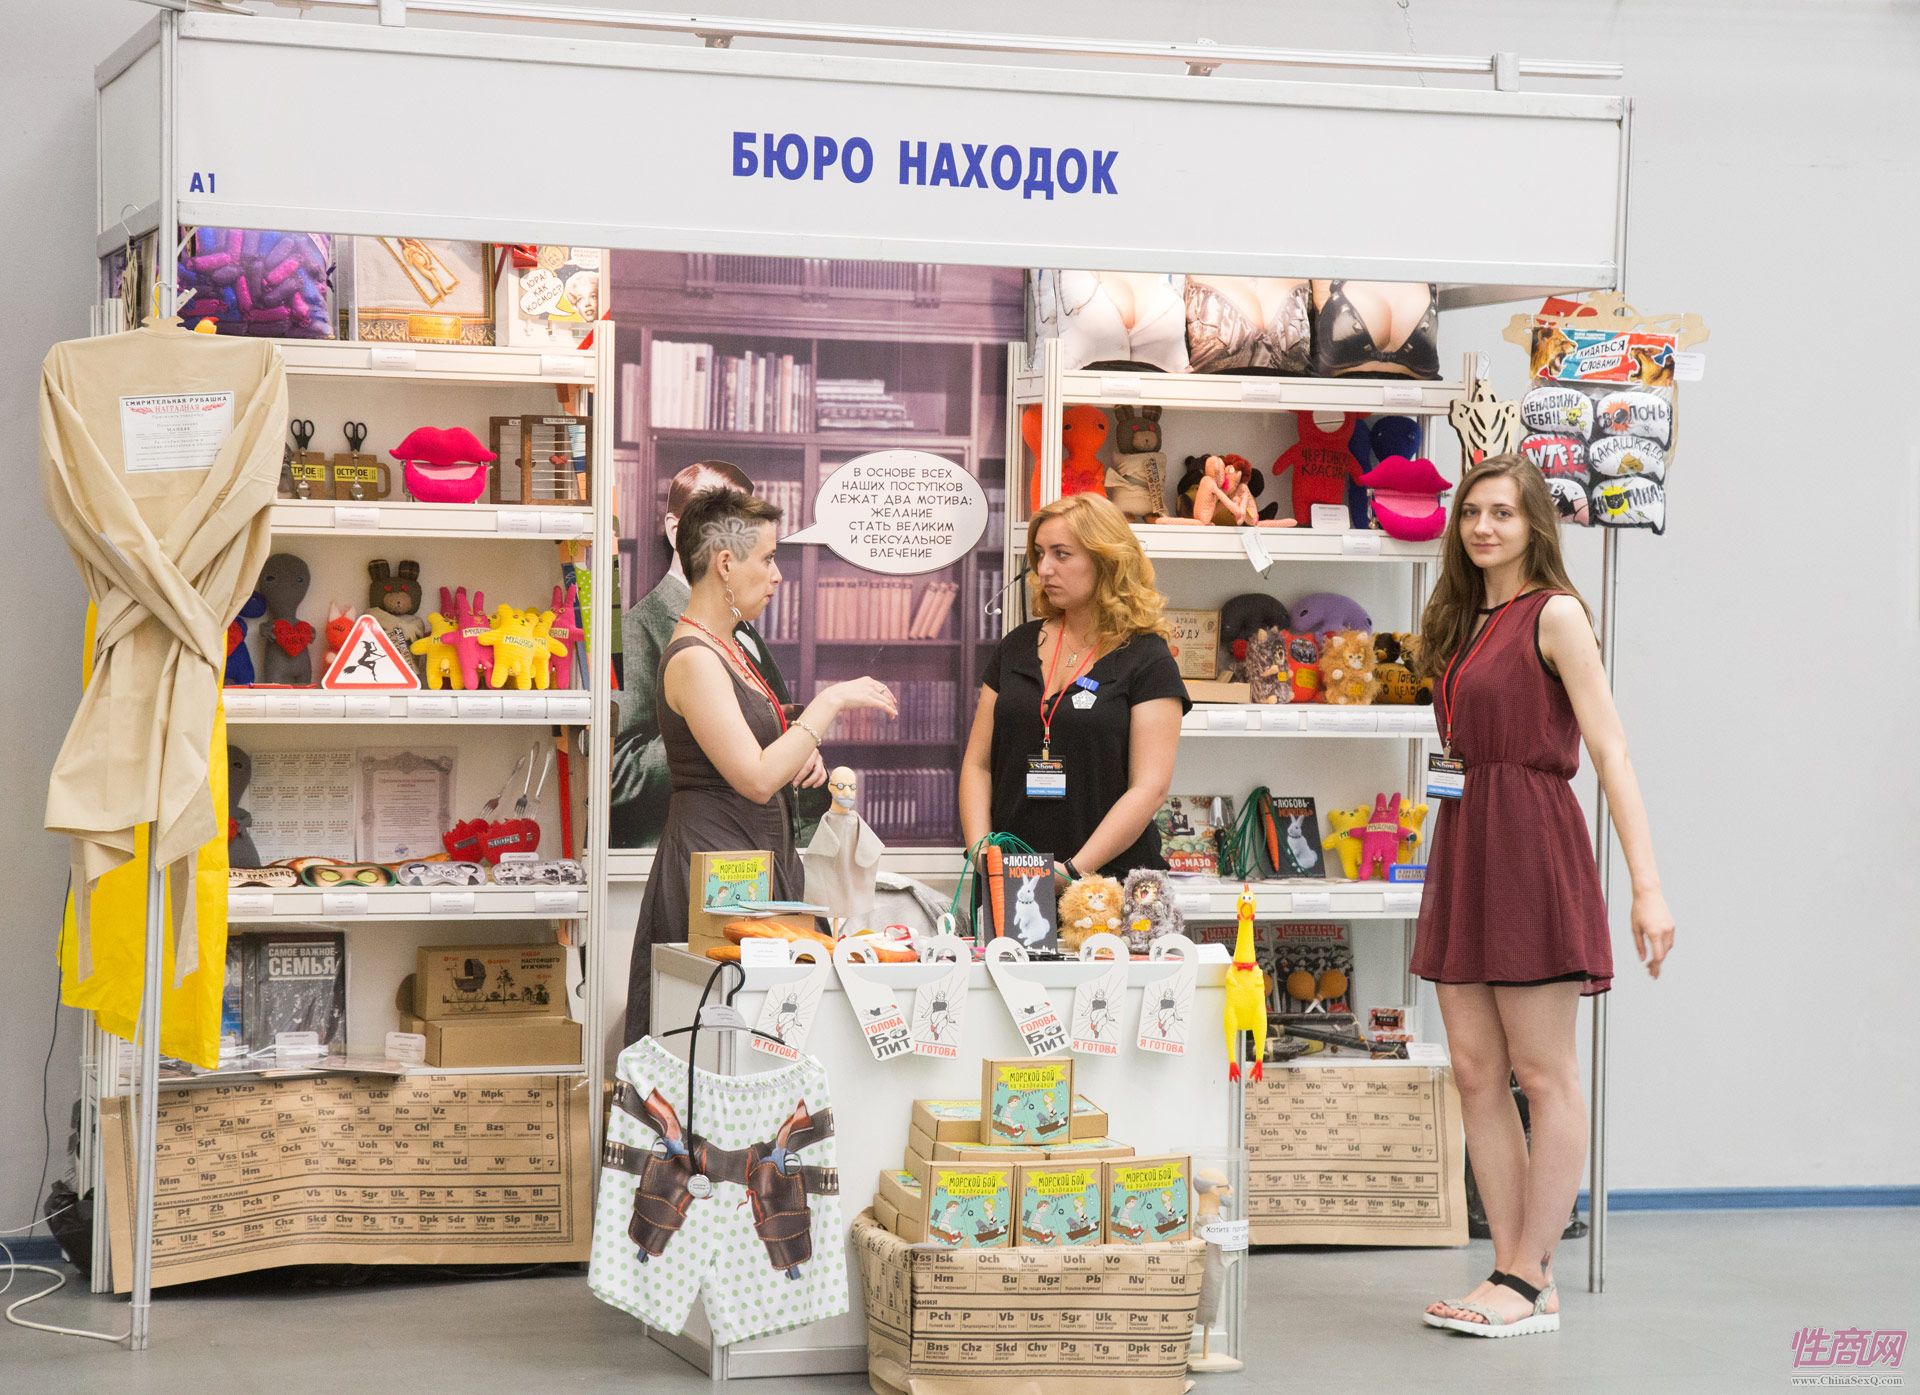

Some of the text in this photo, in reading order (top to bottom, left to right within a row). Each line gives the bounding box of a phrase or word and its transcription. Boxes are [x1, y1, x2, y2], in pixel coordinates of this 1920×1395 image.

[733, 132, 1118, 200] БЮРО НАХОДОК
[534, 285, 548, 296] КАК
[526, 285, 562, 312] КОСМОС?
[1580, 340, 1625, 357] КИДАТЬСЯ
[126, 398, 187, 406] СМИРИТЕЛЬНАЯ
[1524, 394, 1580, 414] НЕНАВИЖУ
[854, 468, 952, 479] В ОСНОВЕ ВСЕХ
[842, 481, 963, 492] НАШИХ ПОСТУПКОВ
[830, 494, 972, 506] ЛЕЖАТ ДВА МОТИВА:
[871, 508, 933, 518] ЖЕЛАНИЕ
[849, 522, 954, 532] СТАТЬ ВЕЛИКИМ
[851, 535, 952, 545] И СЕКСУАЛЬНОЕ
[870, 548, 932, 558] ВЛЕЧЕНИЕ
[720, 862, 758, 874] МОРСКОЙ БОЙ
[268, 948, 298, 957] САМОЕ
[268, 956, 336, 976] СЕМЬЯ
[865, 1017, 904, 1035] ГОЛОВА
[1020, 1016, 1057, 1034] ГОЛОВА
[753, 1039, 798, 1060] Я ГОТОВА
[876, 1037, 911, 1058] ЛИТ
[921, 1043, 957, 1057] ГОТОВА
[1033, 1034, 1065, 1056] ЛИТ
[1073, 1040, 1117, 1054] Я ГОТОВА
[1140, 1039, 1184, 1053] Я ГОТОВА
[1009, 1070, 1055, 1083] МОРСКОЙ БОЙ
[1267, 1082, 1286, 1090] Udv
[369, 1090, 541, 1100] Udv Vp Mpk Sp
[378, 1124, 393, 1133] Dp
[486, 1123, 504, 1131] Bzs
[527, 1123, 541, 1131] Du
[379, 1157, 541, 1165] Pb Ud Ur
[949, 1176, 996, 1188] МОРСКОЙ БОЙ
[1038, 1173, 1085, 1187] МОРСКОЙ БОЙ
[1125, 1169, 1172, 1183] МОРСКОЙ БОЙ
[242, 1197, 263, 1207] Pch
[361, 1190, 378, 1199] Sgr
[243, 1223, 264, 1232] Bns
[419, 1215, 439, 1225] Dpk
[936, 1254, 953, 1263] Isk
[978, 1254, 1000, 1263] Och
[1063, 1255, 1086, 1264] Uoh
[1106, 1256, 1120, 1264] Vo
[1147, 1255, 1160, 1264] Rt
[934, 1274, 1185, 1285] Hm Bu Ngz Pb Nv Ud
[929, 1312, 1169, 1323] Pch P Vb Us Sgr Uk Pw K
[927, 1342, 1177, 1353] Bns Chz Skd Chv Pg Tg Dpk Sdr
